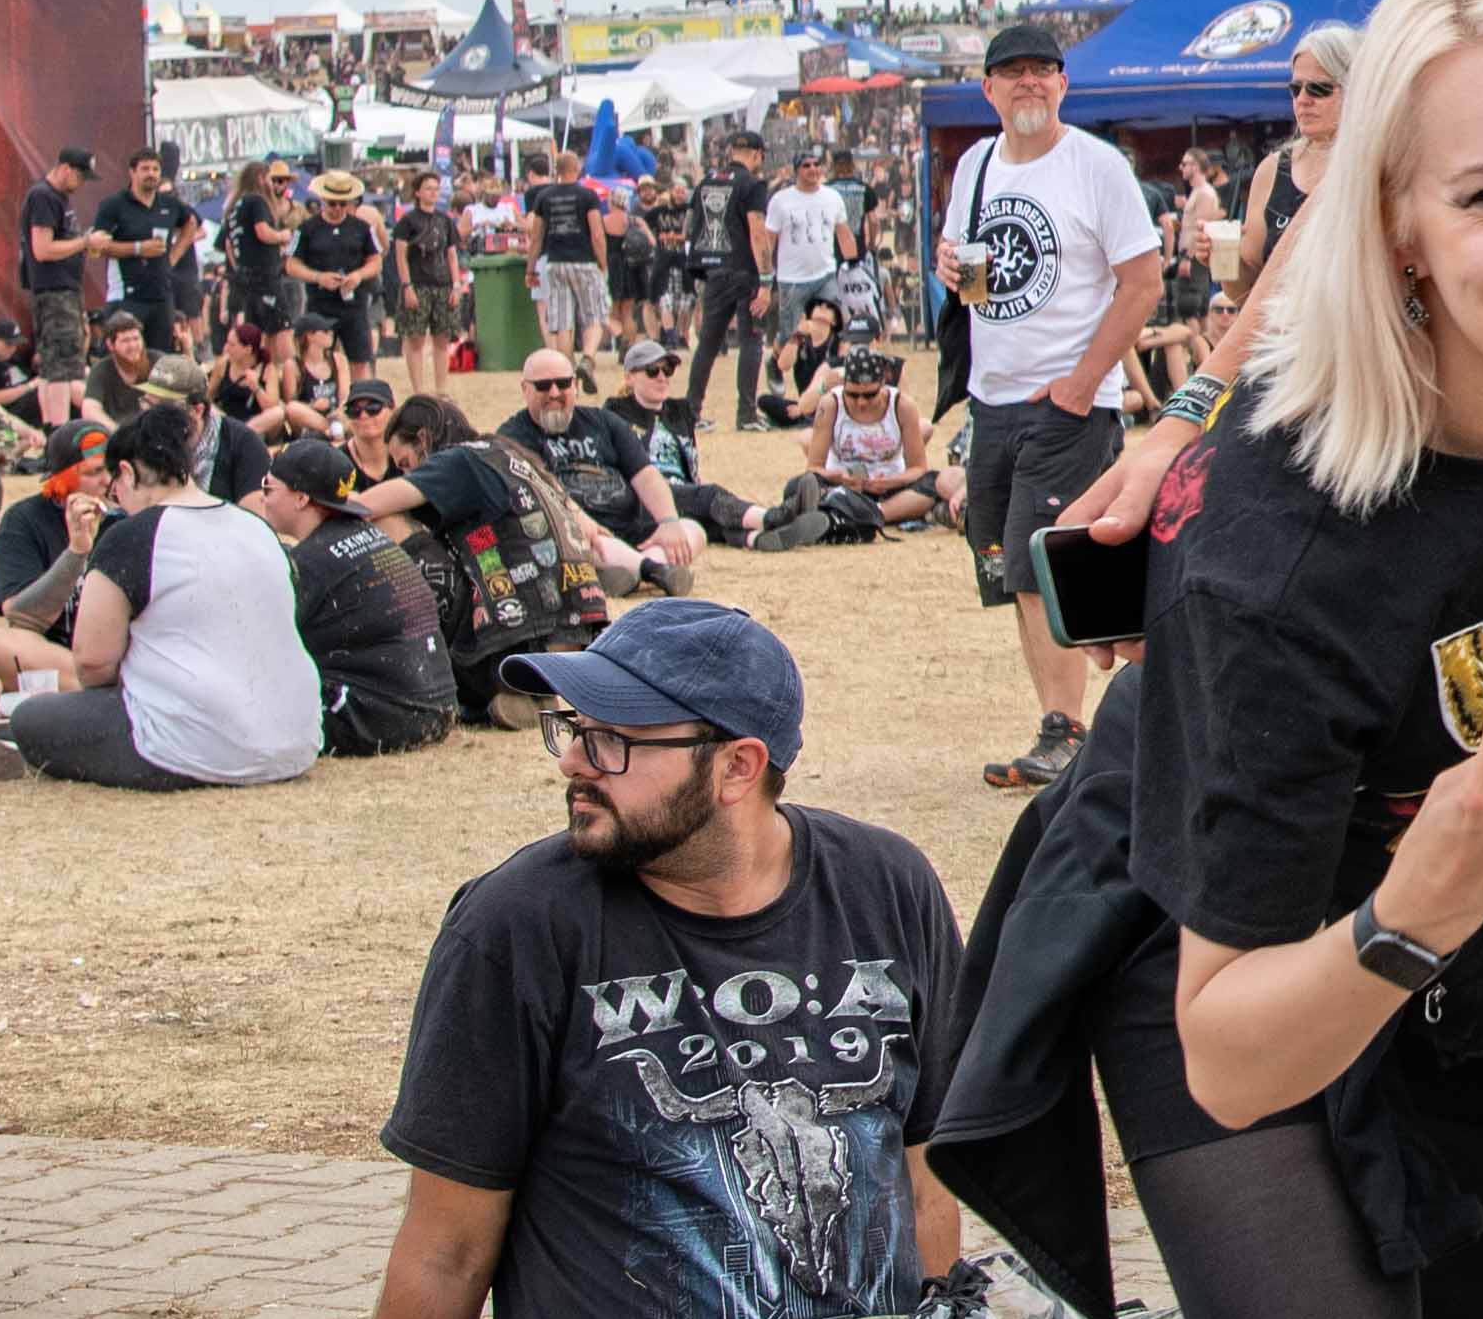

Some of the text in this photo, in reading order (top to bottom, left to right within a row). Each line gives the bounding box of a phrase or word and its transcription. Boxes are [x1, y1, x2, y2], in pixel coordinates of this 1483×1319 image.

[1014, 199, 1054, 253] BREEZE
[998, 297, 1029, 319] AIR
[1033, 262, 1054, 299] 2022
[328, 529, 374, 559] ESKIMO
[678, 1026, 870, 1075] 2019
